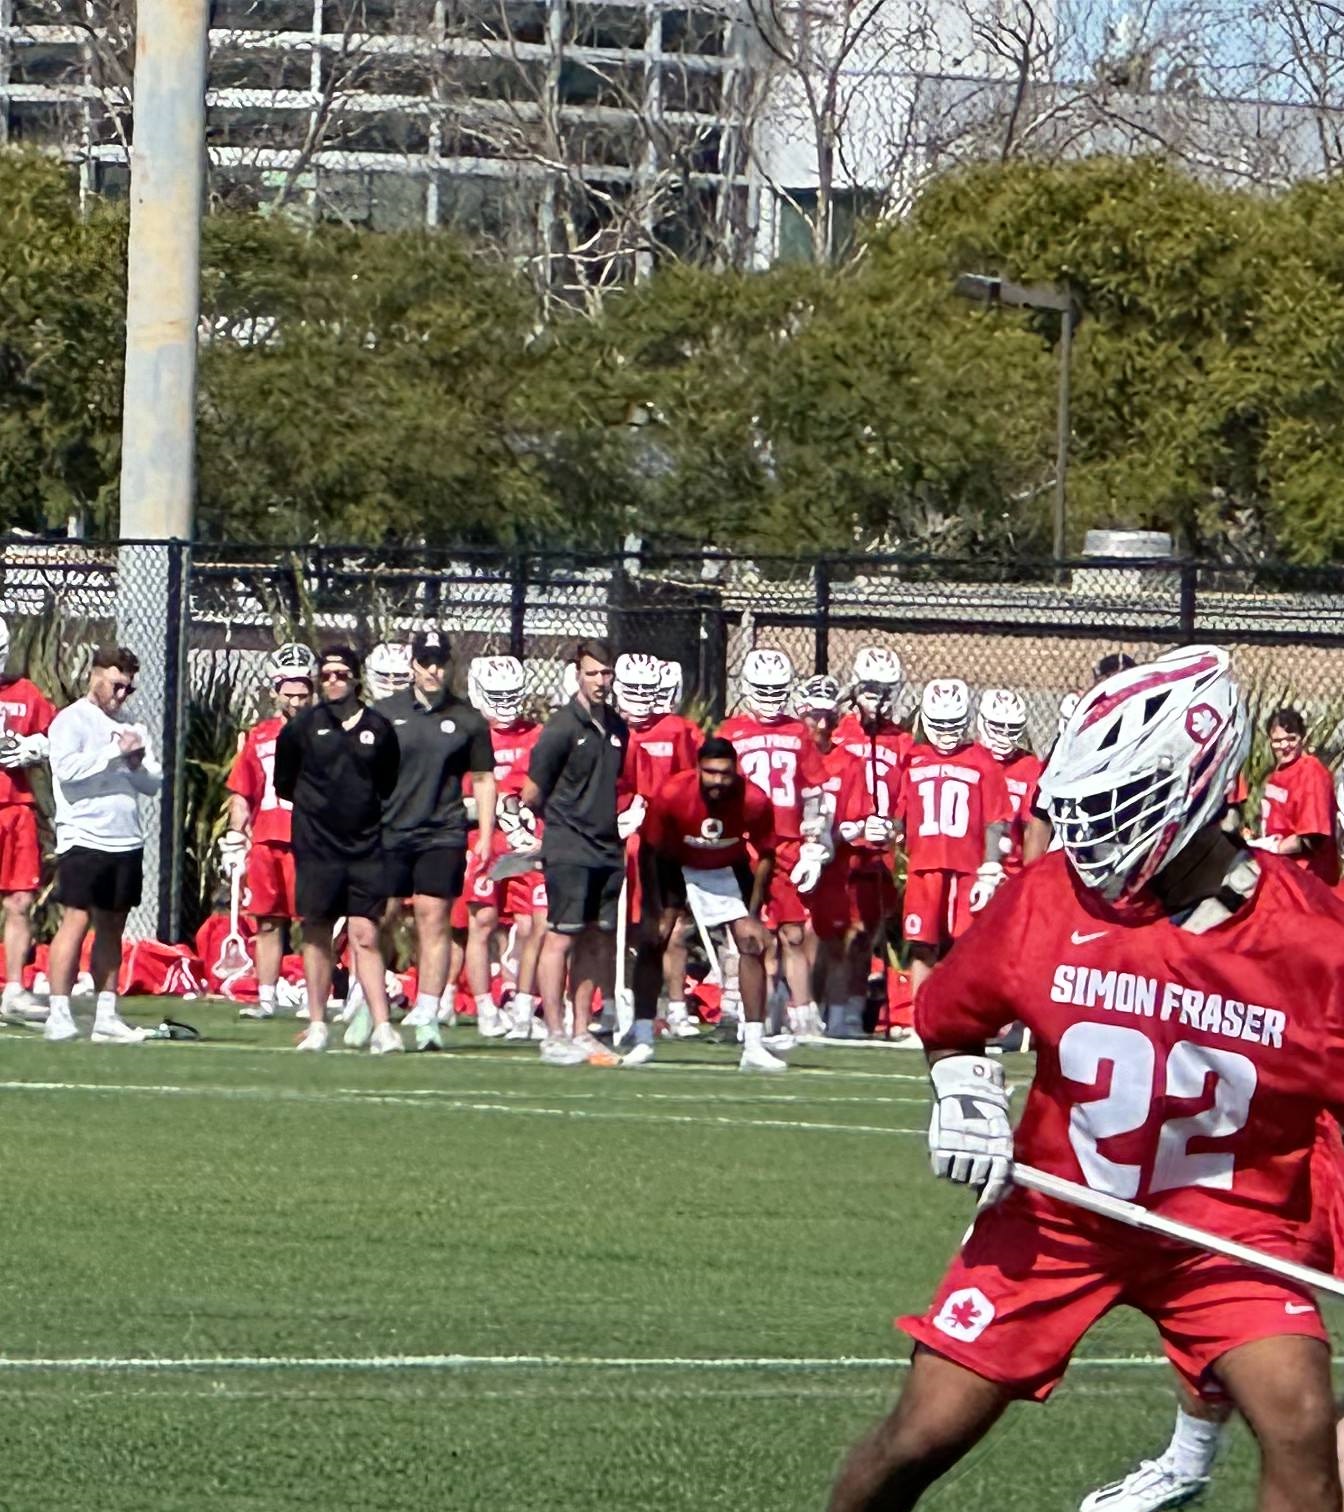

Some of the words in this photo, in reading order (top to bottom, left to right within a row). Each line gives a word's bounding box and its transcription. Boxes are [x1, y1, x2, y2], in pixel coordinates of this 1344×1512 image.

[918, 780, 970, 838] 10
[1050, 964, 1158, 1018] SIMON
[1159, 982, 1287, 1049] FRASER
[1058, 1021, 1258, 1200] 22
